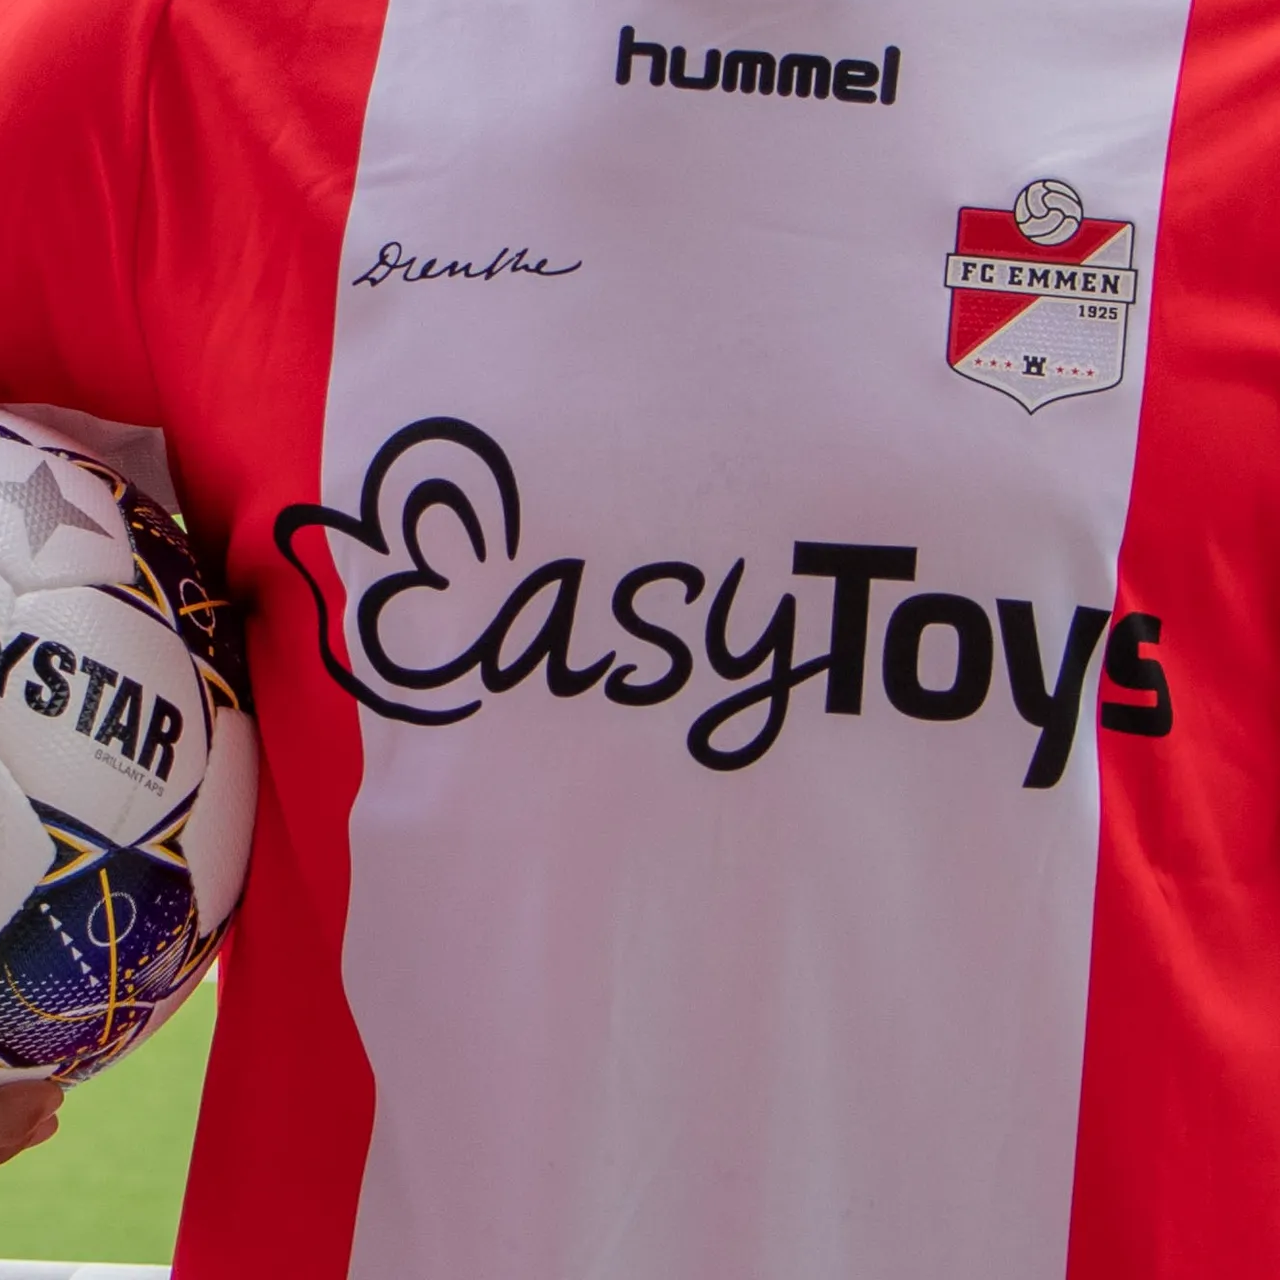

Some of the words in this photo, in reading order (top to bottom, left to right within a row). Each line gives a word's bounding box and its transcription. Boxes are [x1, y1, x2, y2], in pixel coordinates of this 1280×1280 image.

[615, 25, 901, 105] hummel
[961, 262, 995, 284] FC
[1008, 266, 1121, 295] EMMEN
[1078, 304, 1120, 321] 1925
[356, 417, 1174, 790] EasyToys
[94, 748, 146, 784] BRILLANT
[143, 780, 166, 798] APS
